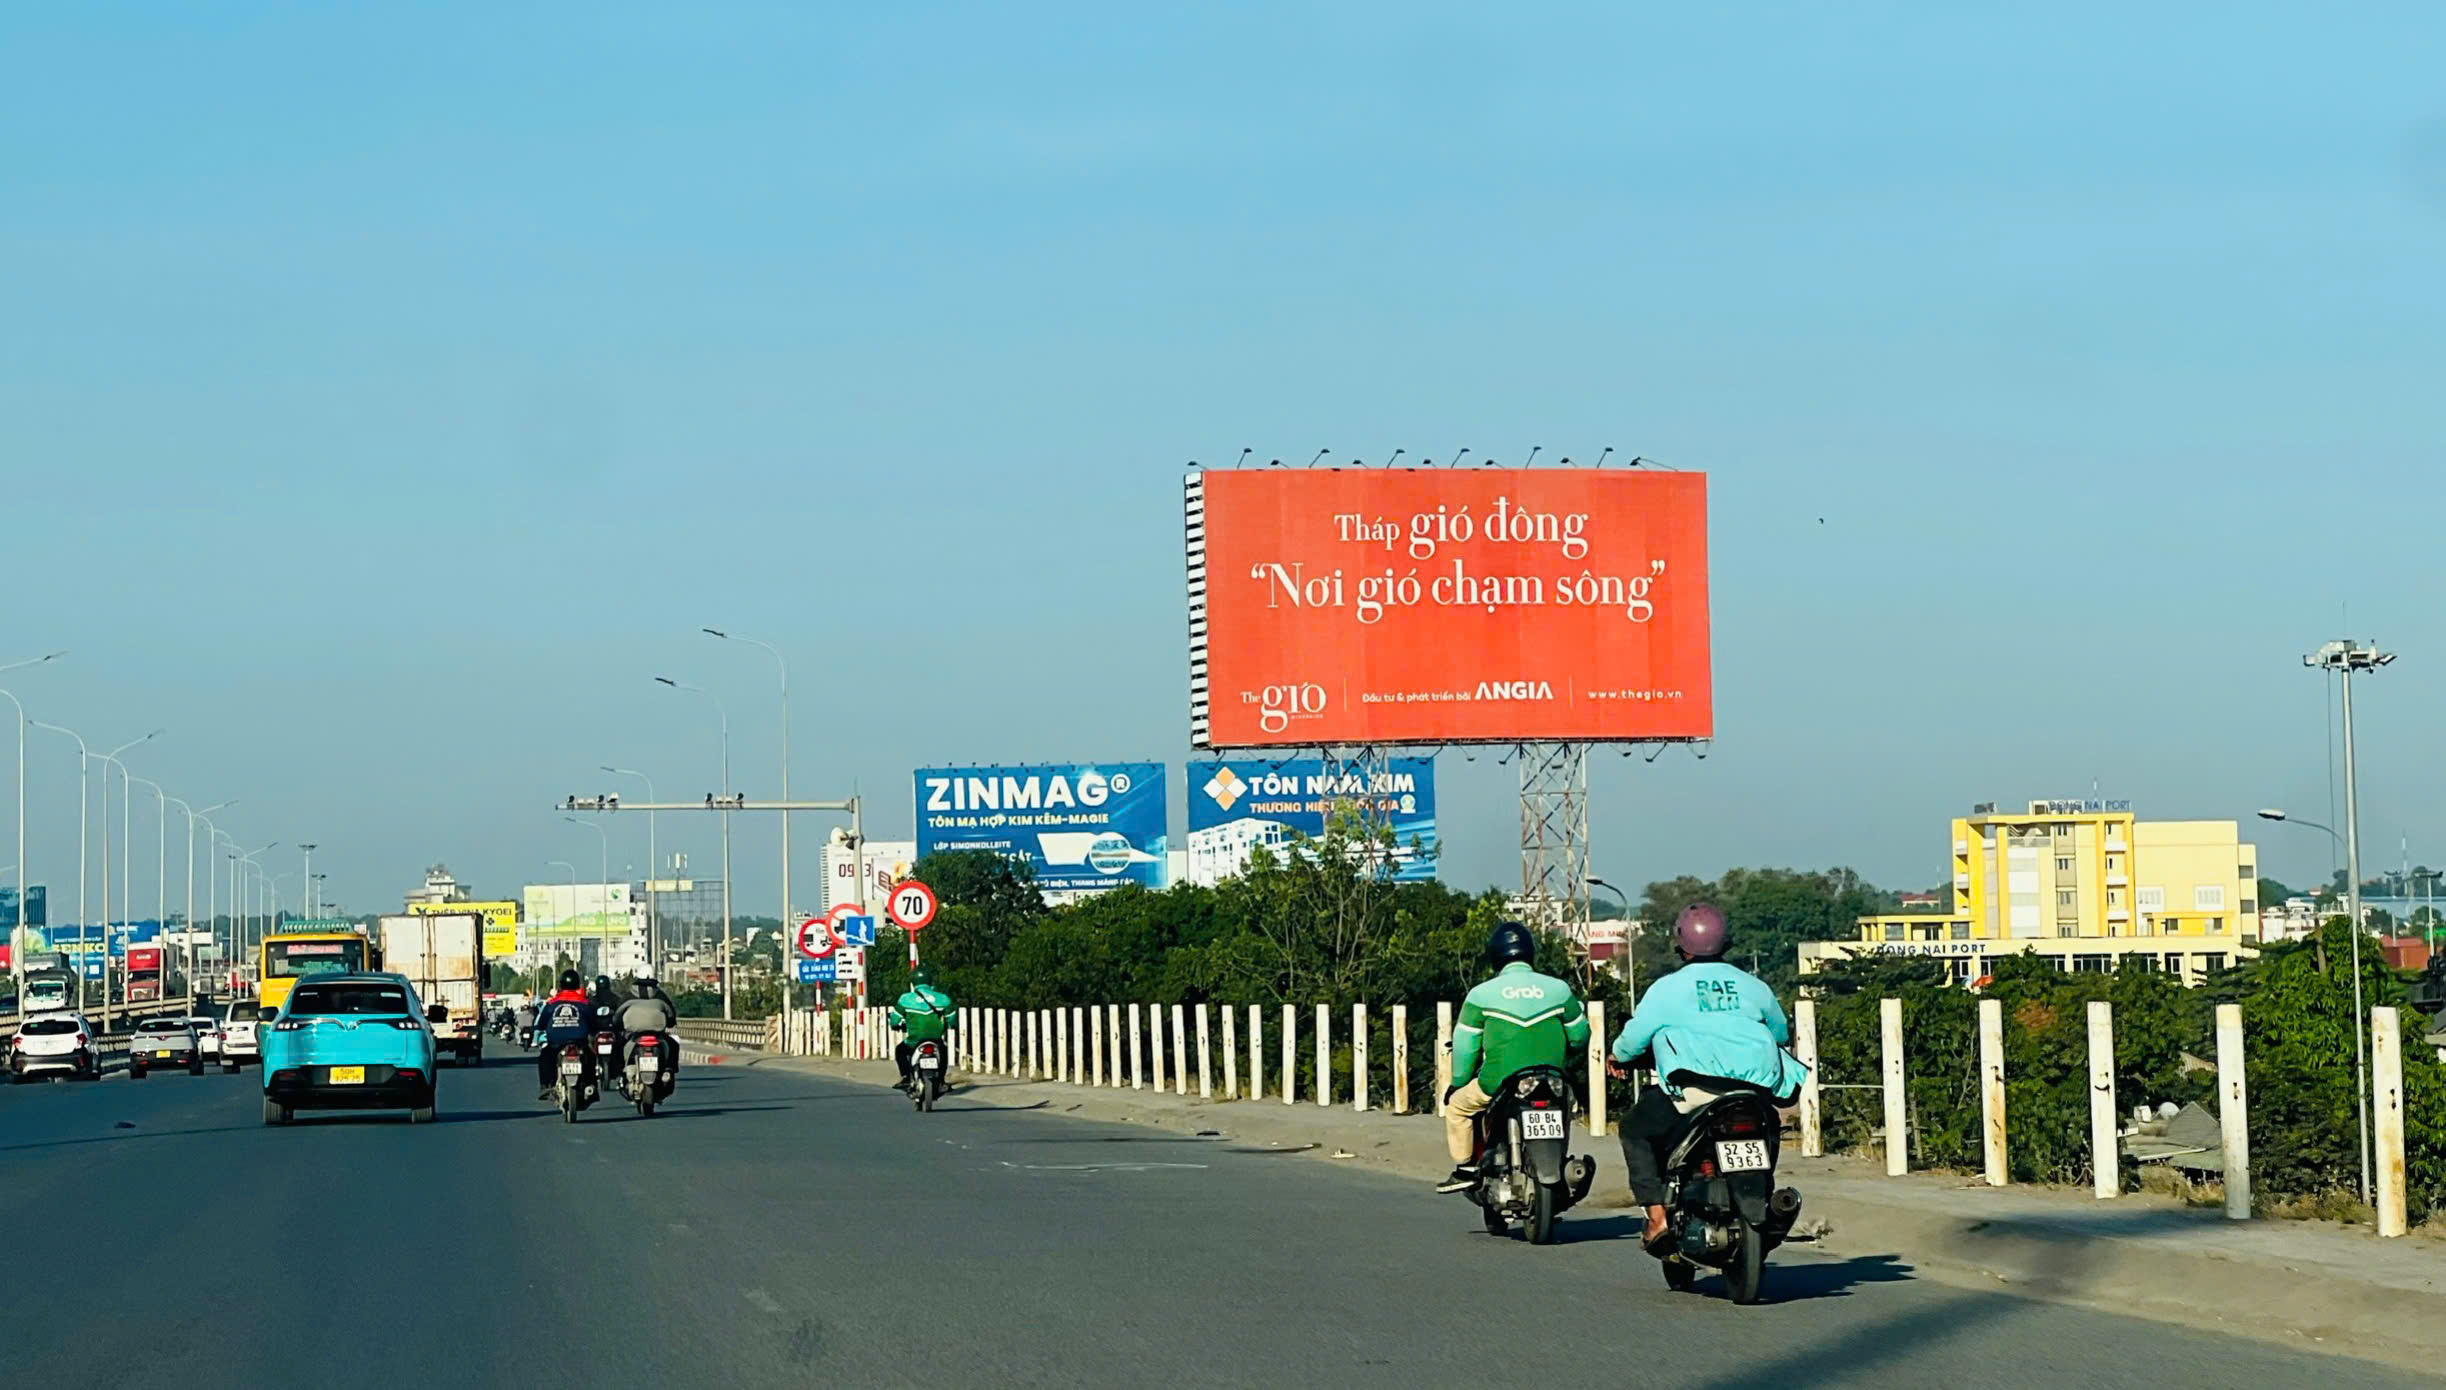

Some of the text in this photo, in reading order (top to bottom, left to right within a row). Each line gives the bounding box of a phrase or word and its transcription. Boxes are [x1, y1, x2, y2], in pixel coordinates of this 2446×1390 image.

[1334, 495, 1589, 559] Tháp gió đông
[1356, 567, 1422, 624] gió
[1431, 558, 1545, 614] chạm
[1240, 691, 1261, 704] The
[1397, 692, 1404, 702] &
[1406, 692, 1429, 704] phát
[1474, 681, 1553, 700] ANGIA
[1588, 689, 1683, 700] www.thegio.vn
[1249, 772, 1415, 796] TÔN NAM KIM
[1250, 802, 1301, 813] THƯƠNG
[2105, 800, 2131, 810] PORT
[928, 815, 954, 828] TÔN
[957, 817, 978, 829] MẠ
[980, 814, 1006, 828] HỢP
[1009, 816, 1033, 826] KIM
[483, 907, 512, 915] KYOEI
[903, 896, 922, 915] 70
[1923, 944, 1946, 954] NAI
[1952, 944, 1986, 953] PORT
[1502, 985, 1544, 999] Grab
[1727, 1155, 1763, 1168] 9363
